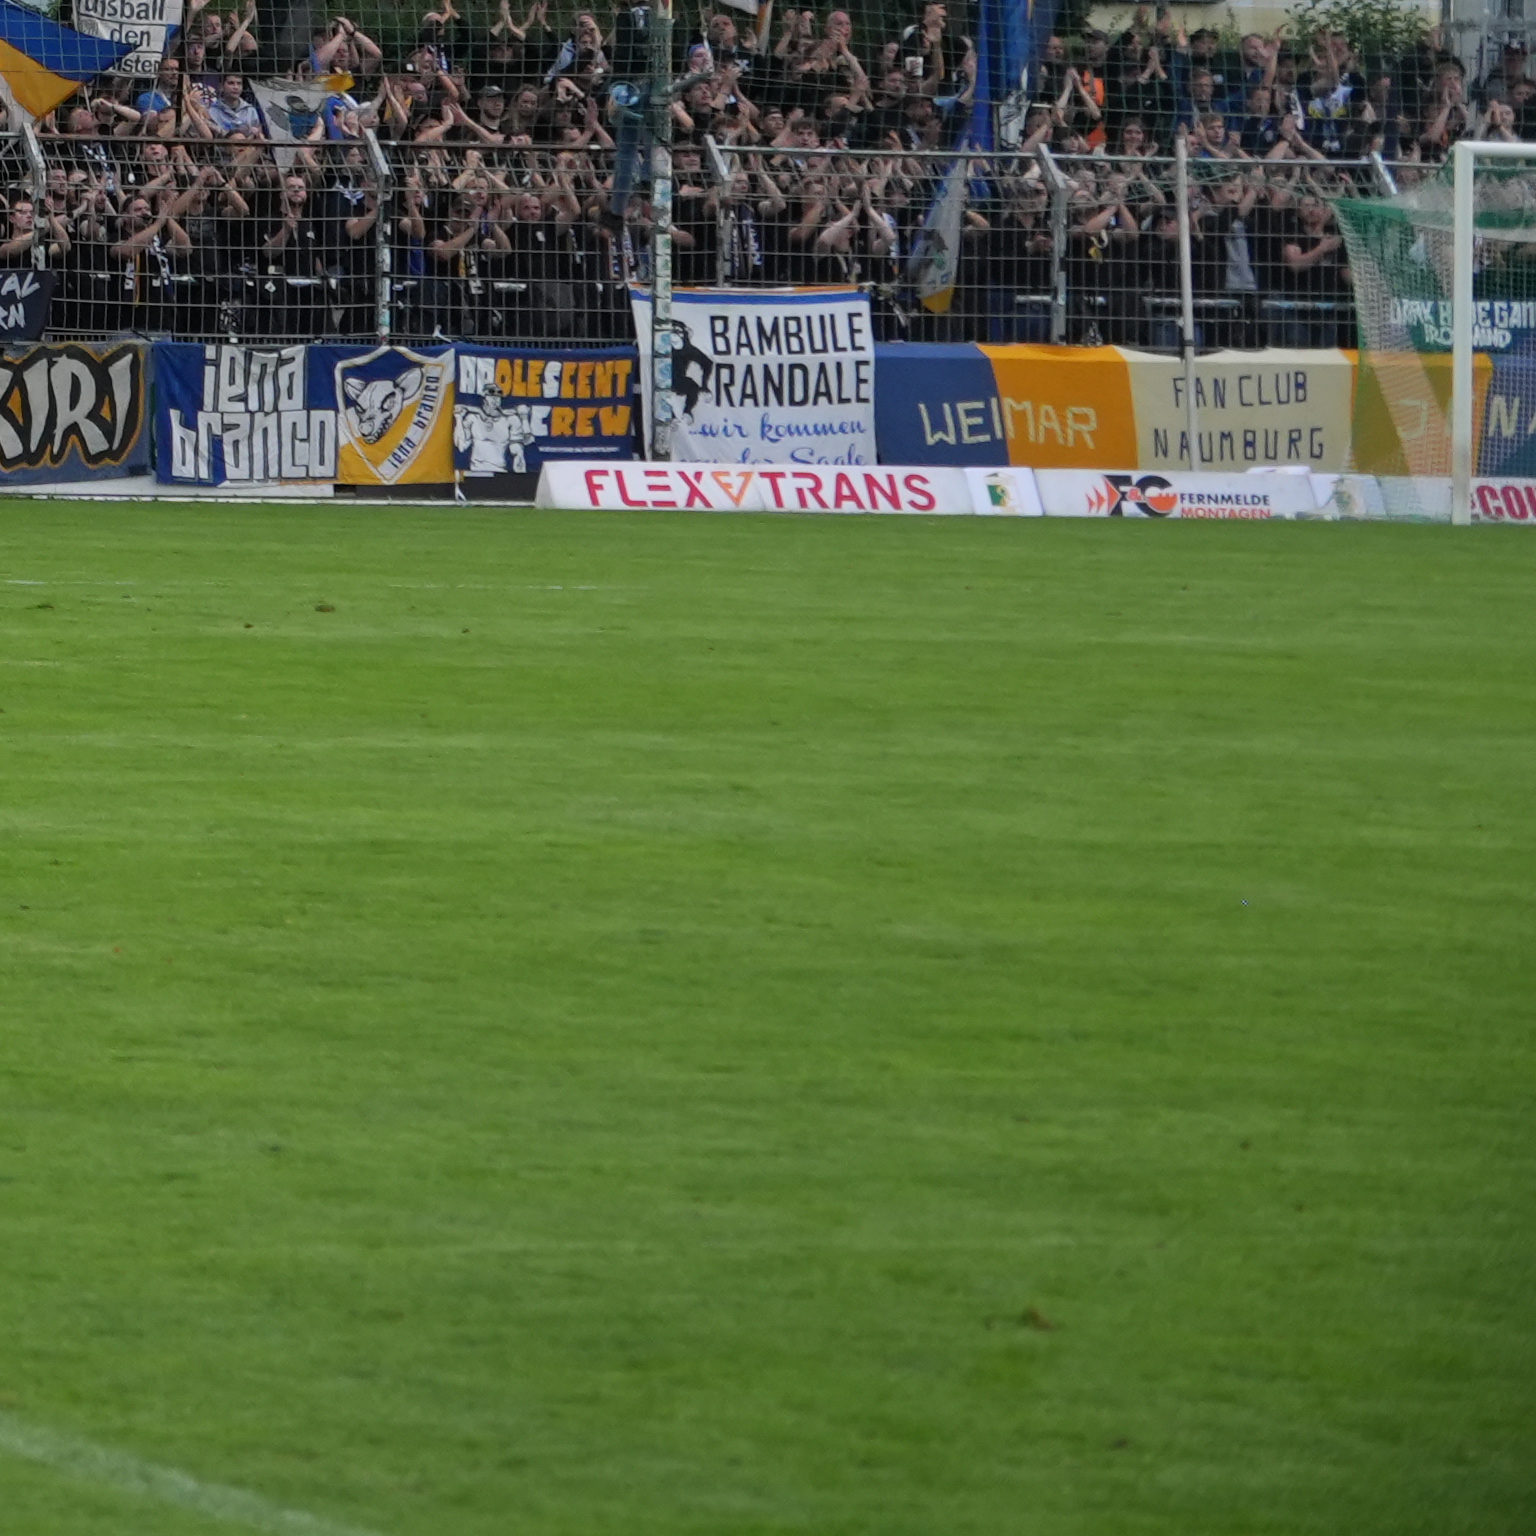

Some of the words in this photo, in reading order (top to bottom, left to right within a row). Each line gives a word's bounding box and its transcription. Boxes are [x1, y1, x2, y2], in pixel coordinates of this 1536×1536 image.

[110, 23, 150, 47] den
[710, 312, 866, 356] BAMBULE
[202, 344, 308, 412] iena
[459, 354, 632, 399] ADOLESCENT
[713, 360, 871, 408] RANDALE
[1172, 375, 1227, 410] FAN
[1237, 371, 1309, 407] CLUB
[530, 405, 631, 437] CREW
[760, 413, 867, 443] kommen
[918, 397, 1098, 450] WEIMAR
[170, 409, 339, 480] branco
[1153, 427, 1325, 463] NAUMBURG
[1180, 492, 1270, 507] FERNMELDE
[1181, 507, 1271, 519] MONTAGEN
